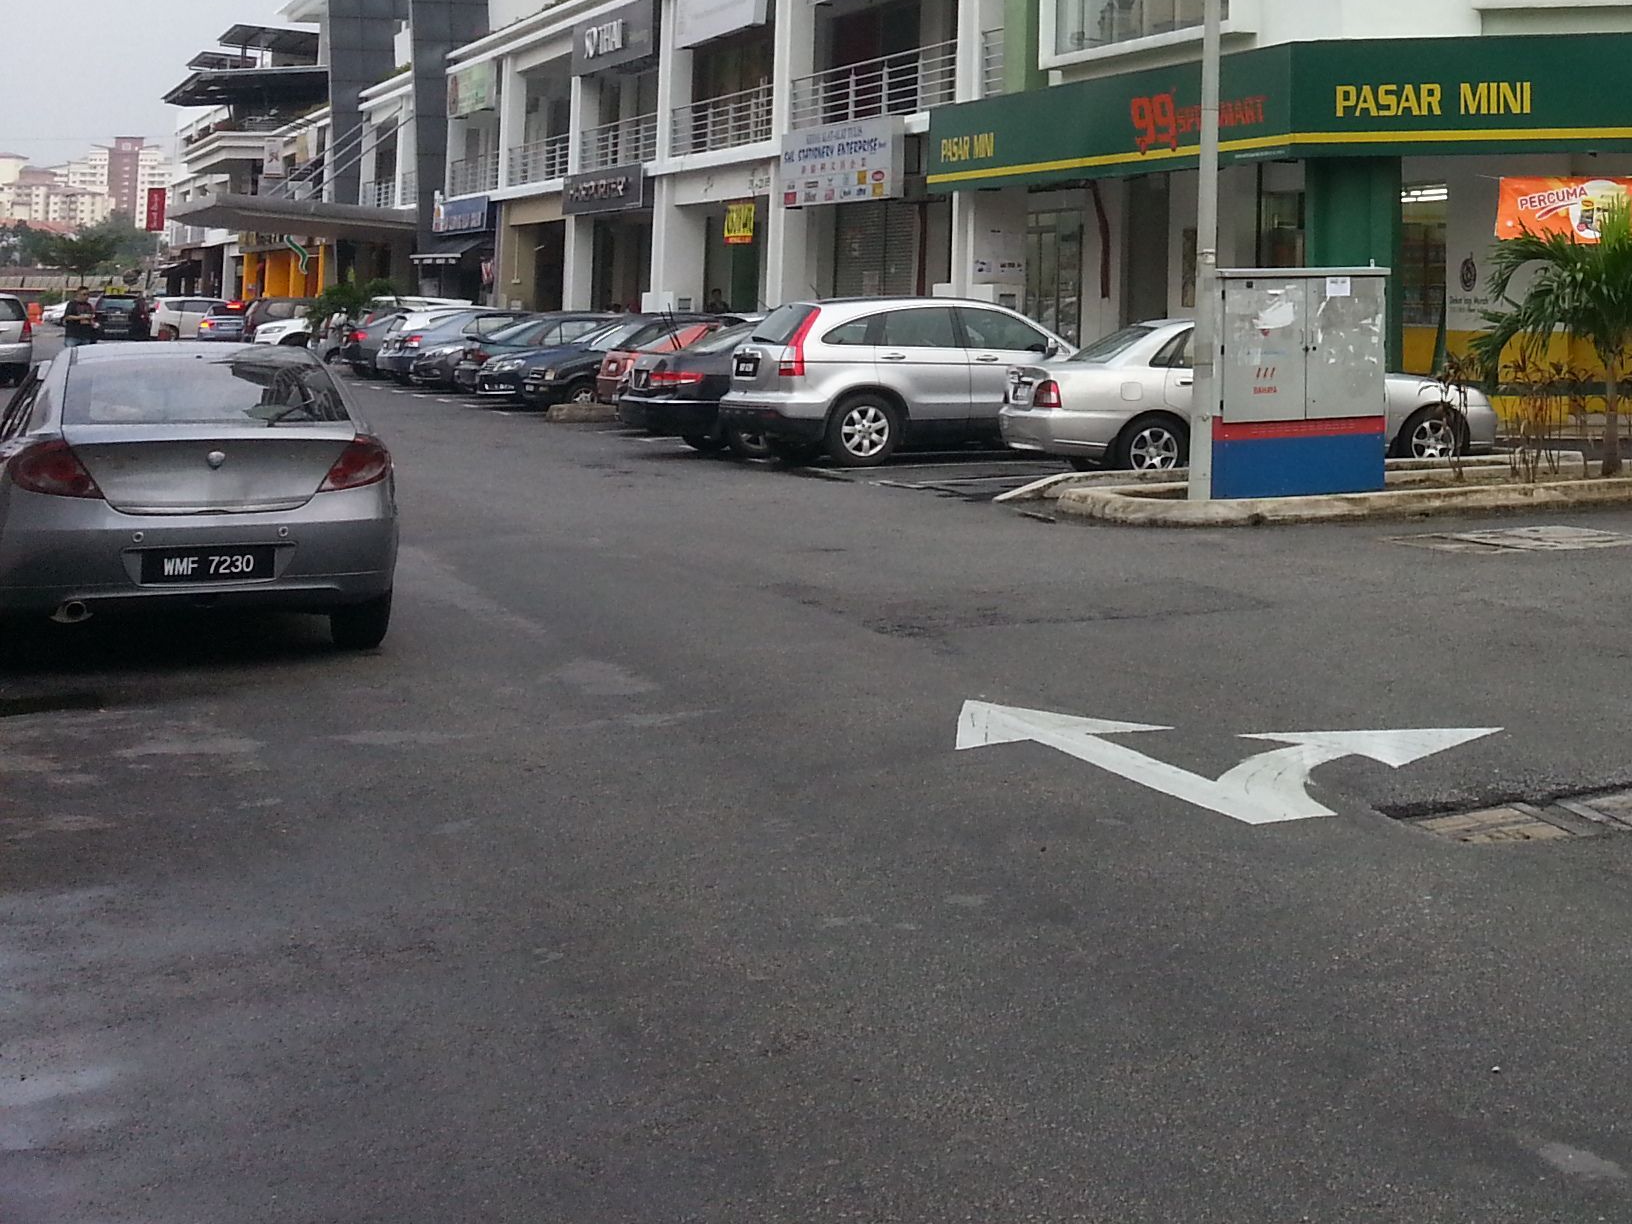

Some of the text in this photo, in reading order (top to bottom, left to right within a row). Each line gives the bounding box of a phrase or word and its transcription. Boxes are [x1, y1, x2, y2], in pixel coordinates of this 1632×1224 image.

[1335, 81, 1531, 117] PASAR MINI
[1130, 92, 1177, 155] 99
[941, 132, 994, 163] PASAR MINI
[1518, 185, 1588, 210] PERCUMA
[164, 555, 254, 575] WMF 7230
